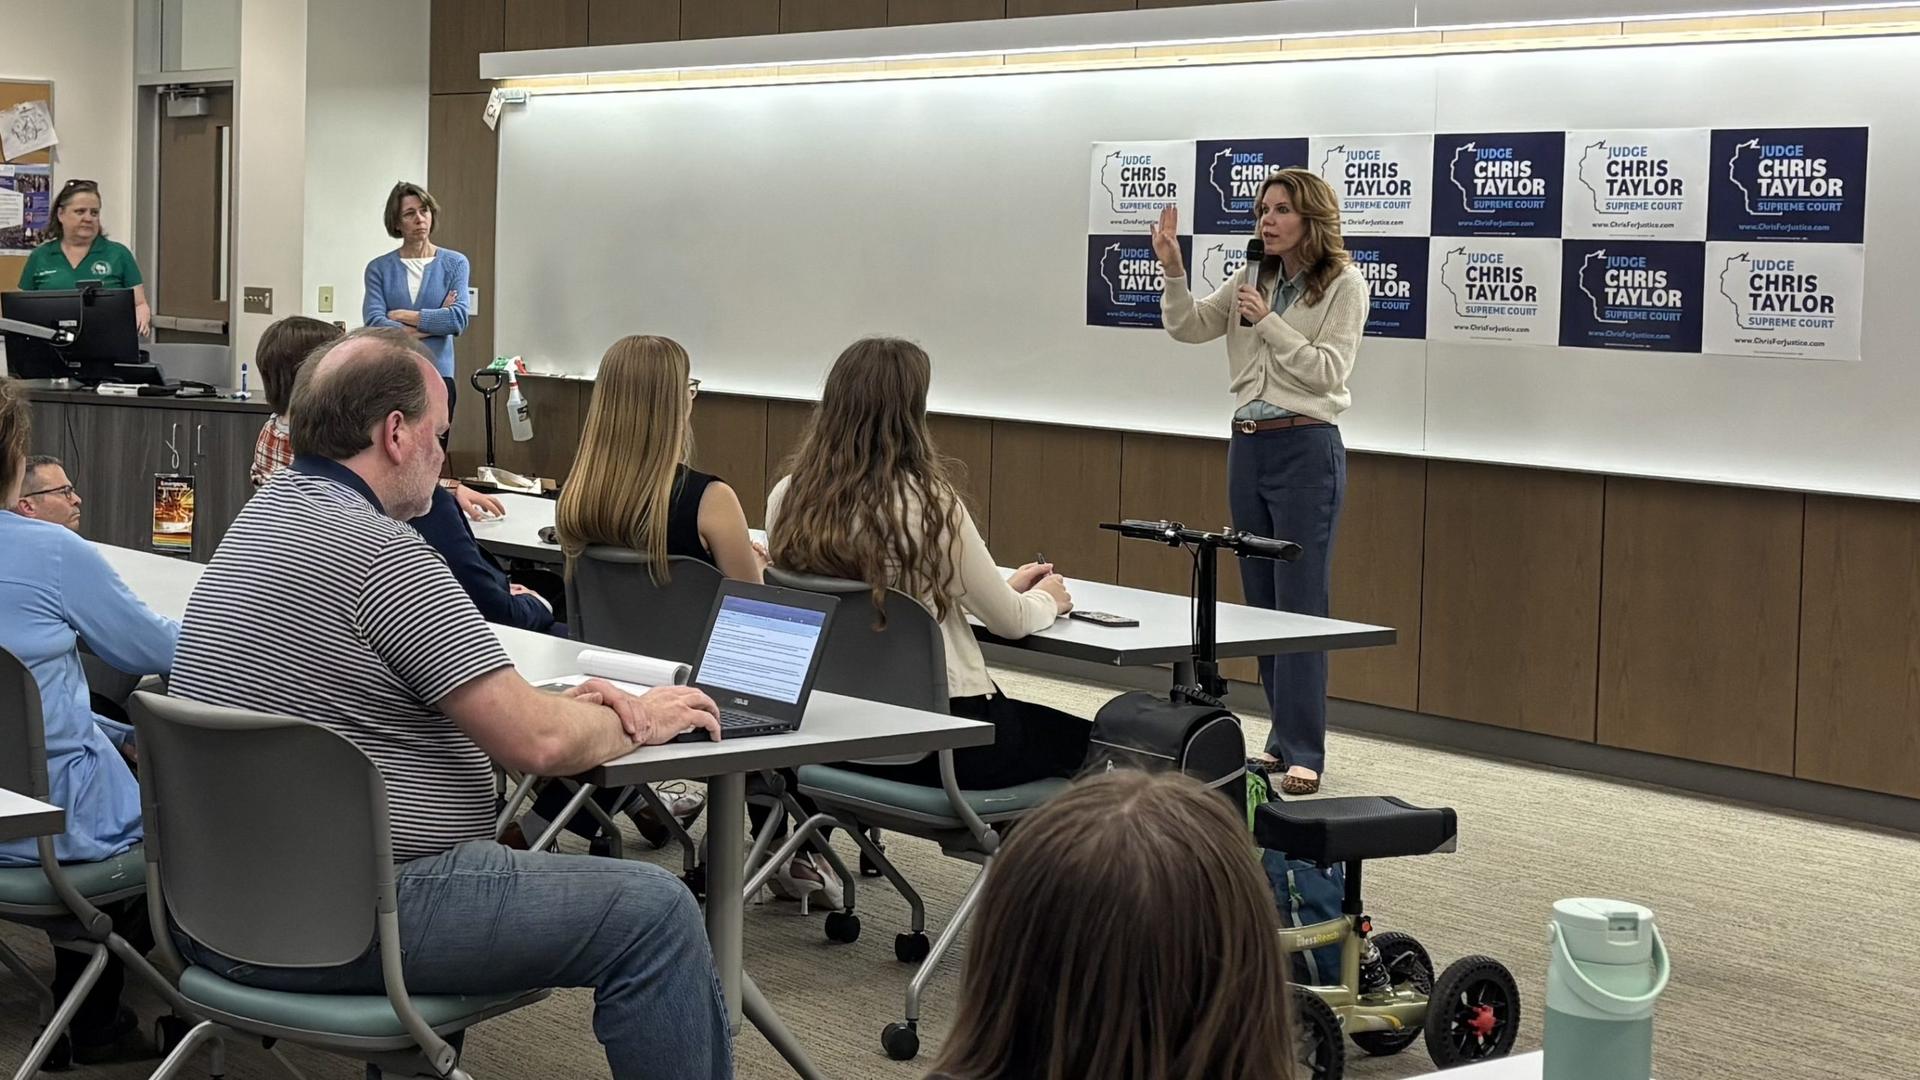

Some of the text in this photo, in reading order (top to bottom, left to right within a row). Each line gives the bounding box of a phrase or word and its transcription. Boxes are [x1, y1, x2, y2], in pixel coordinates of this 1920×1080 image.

[1232, 153, 1263, 164] JUDGE
[1346, 150, 1380, 162] JUDGE
[1476, 148, 1512, 161] JUDGE
[1607, 146, 1648, 159] JUDGE
[1759, 145, 1804, 159] JUDGE
[1121, 155, 1151, 166] JUDGE
[1120, 167, 1166, 181] CHRIS
[1345, 162, 1398, 178] CHRIS
[1474, 160, 1532, 177] CHRIS
[1606, 160, 1668, 177] CHRIS
[1758, 159, 1827, 177] CHRIS
[1120, 183, 1177, 197] TAYLOR
[1230, 181, 1260, 197] TAY
[1344, 180, 1411, 196] TAYLOR
[1473, 178, 1545, 195] TAYLOR
[1605, 178, 1683, 196] TAYLOR
[1757, 178, 1843, 197] TAYLOR
[1344, 201, 1411, 209] SUPREME COURT
[1473, 200, 1545, 208] SUPREME COURT
[1605, 202, 1683, 210] SUPREME COURT
[1757, 203, 1843, 211] SUPREME COURT
[1120, 248, 1150, 259] JUDGE
[1224, 249, 1247, 261] JUDG
[1350, 251, 1379, 261] UDGE
[1466, 253, 1504, 265] JUDGE
[1119, 259, 1164, 275] CHRIS
[1605, 256, 1646, 269] JUDGE
[1750, 260, 1795, 272] JUDGE
[1355, 262, 1398, 279] HRIS
[1466, 266, 1523, 283] CHRIS
[1119, 275, 1166, 291] TAYLO
[1605, 269, 1667, 288] CHRIS
[1749, 274, 1818, 293] CHRIS
[1367, 280, 1410, 297] YLOR
[1465, 284, 1537, 302] TAYLOR
[1604, 288, 1682, 307] TAYLOR
[1749, 293, 1834, 313] TAYLOR
[1382, 301, 1410, 310] COURT
[1465, 306, 1538, 316] SUPREME COURT
[1604, 310, 1682, 321] SUPREME COURT
[1748, 317, 1834, 328] SUPREME COURT
